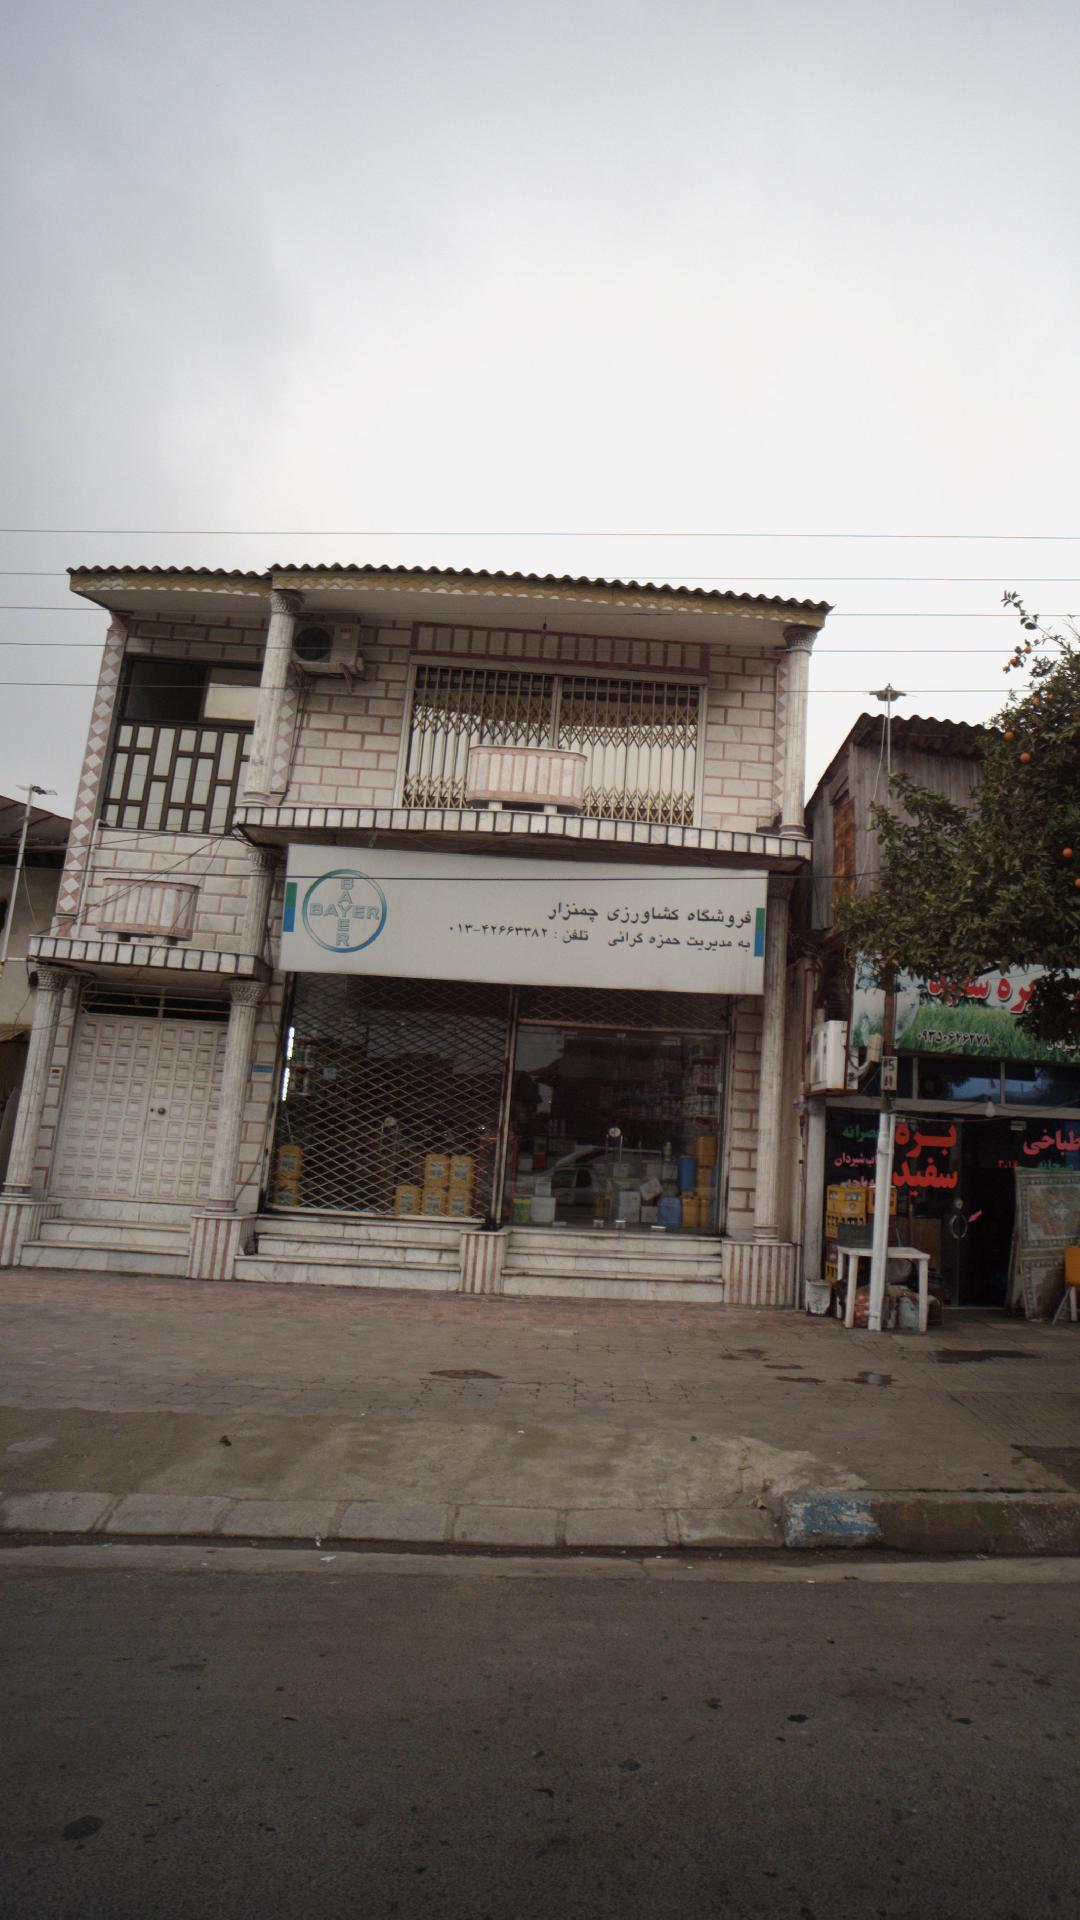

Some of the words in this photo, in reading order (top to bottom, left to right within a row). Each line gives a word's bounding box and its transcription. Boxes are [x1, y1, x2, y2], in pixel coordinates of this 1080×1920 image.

[309, 902, 380, 920] BAYER
[336, 877, 354, 947] BAYER
[548, 902, 599, 923] چمنزار
[607, 905, 680, 925] کشاورزی
[687, 908, 752, 929] فروشگاه
[649, 934, 681, 949] حمزه
[686, 936, 733, 953] مدیریت
[738, 940, 751, 953] به
[895, 1122, 958, 1158] بره
[1023, 1128, 1080, 1156] طباخی
[892, 1157, 959, 1196] سفید
